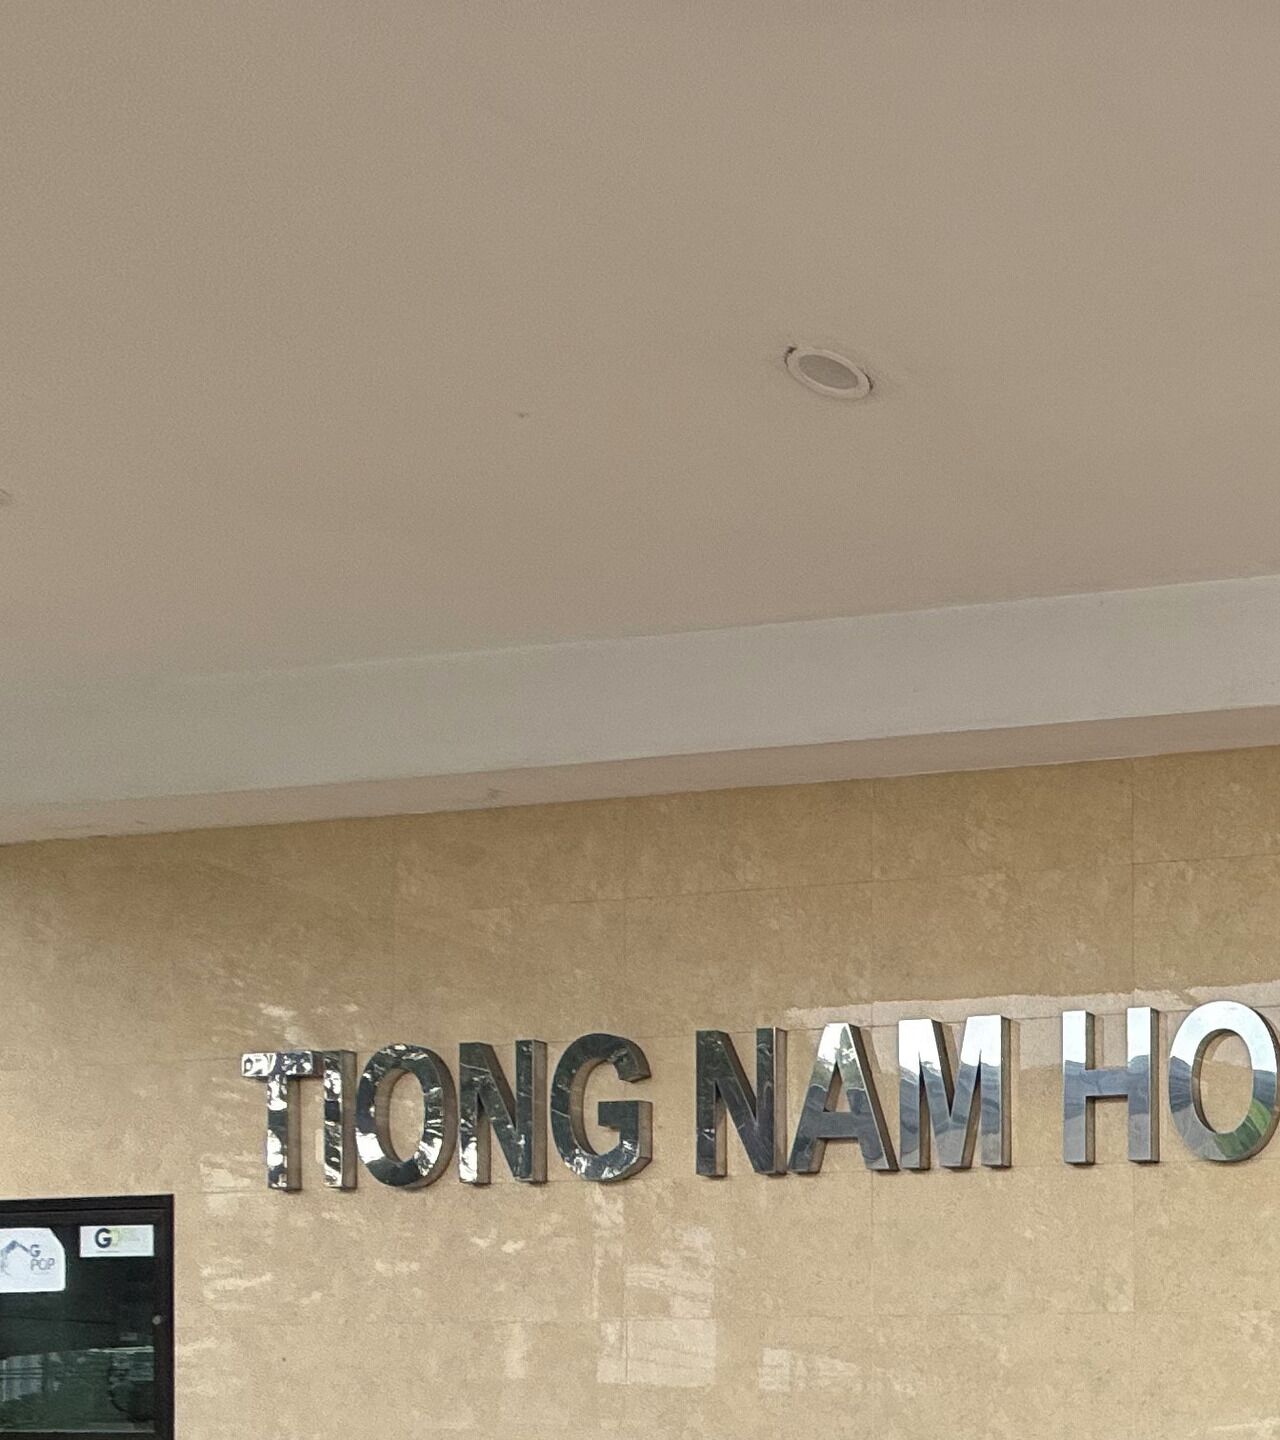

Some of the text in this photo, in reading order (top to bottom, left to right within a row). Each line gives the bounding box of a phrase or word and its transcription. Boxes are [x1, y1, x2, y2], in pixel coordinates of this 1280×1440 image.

[242, 1035, 653, 1192] TIONG
[696, 1014, 1011, 1178] NAM
[30, 1258, 55, 1271] POP
